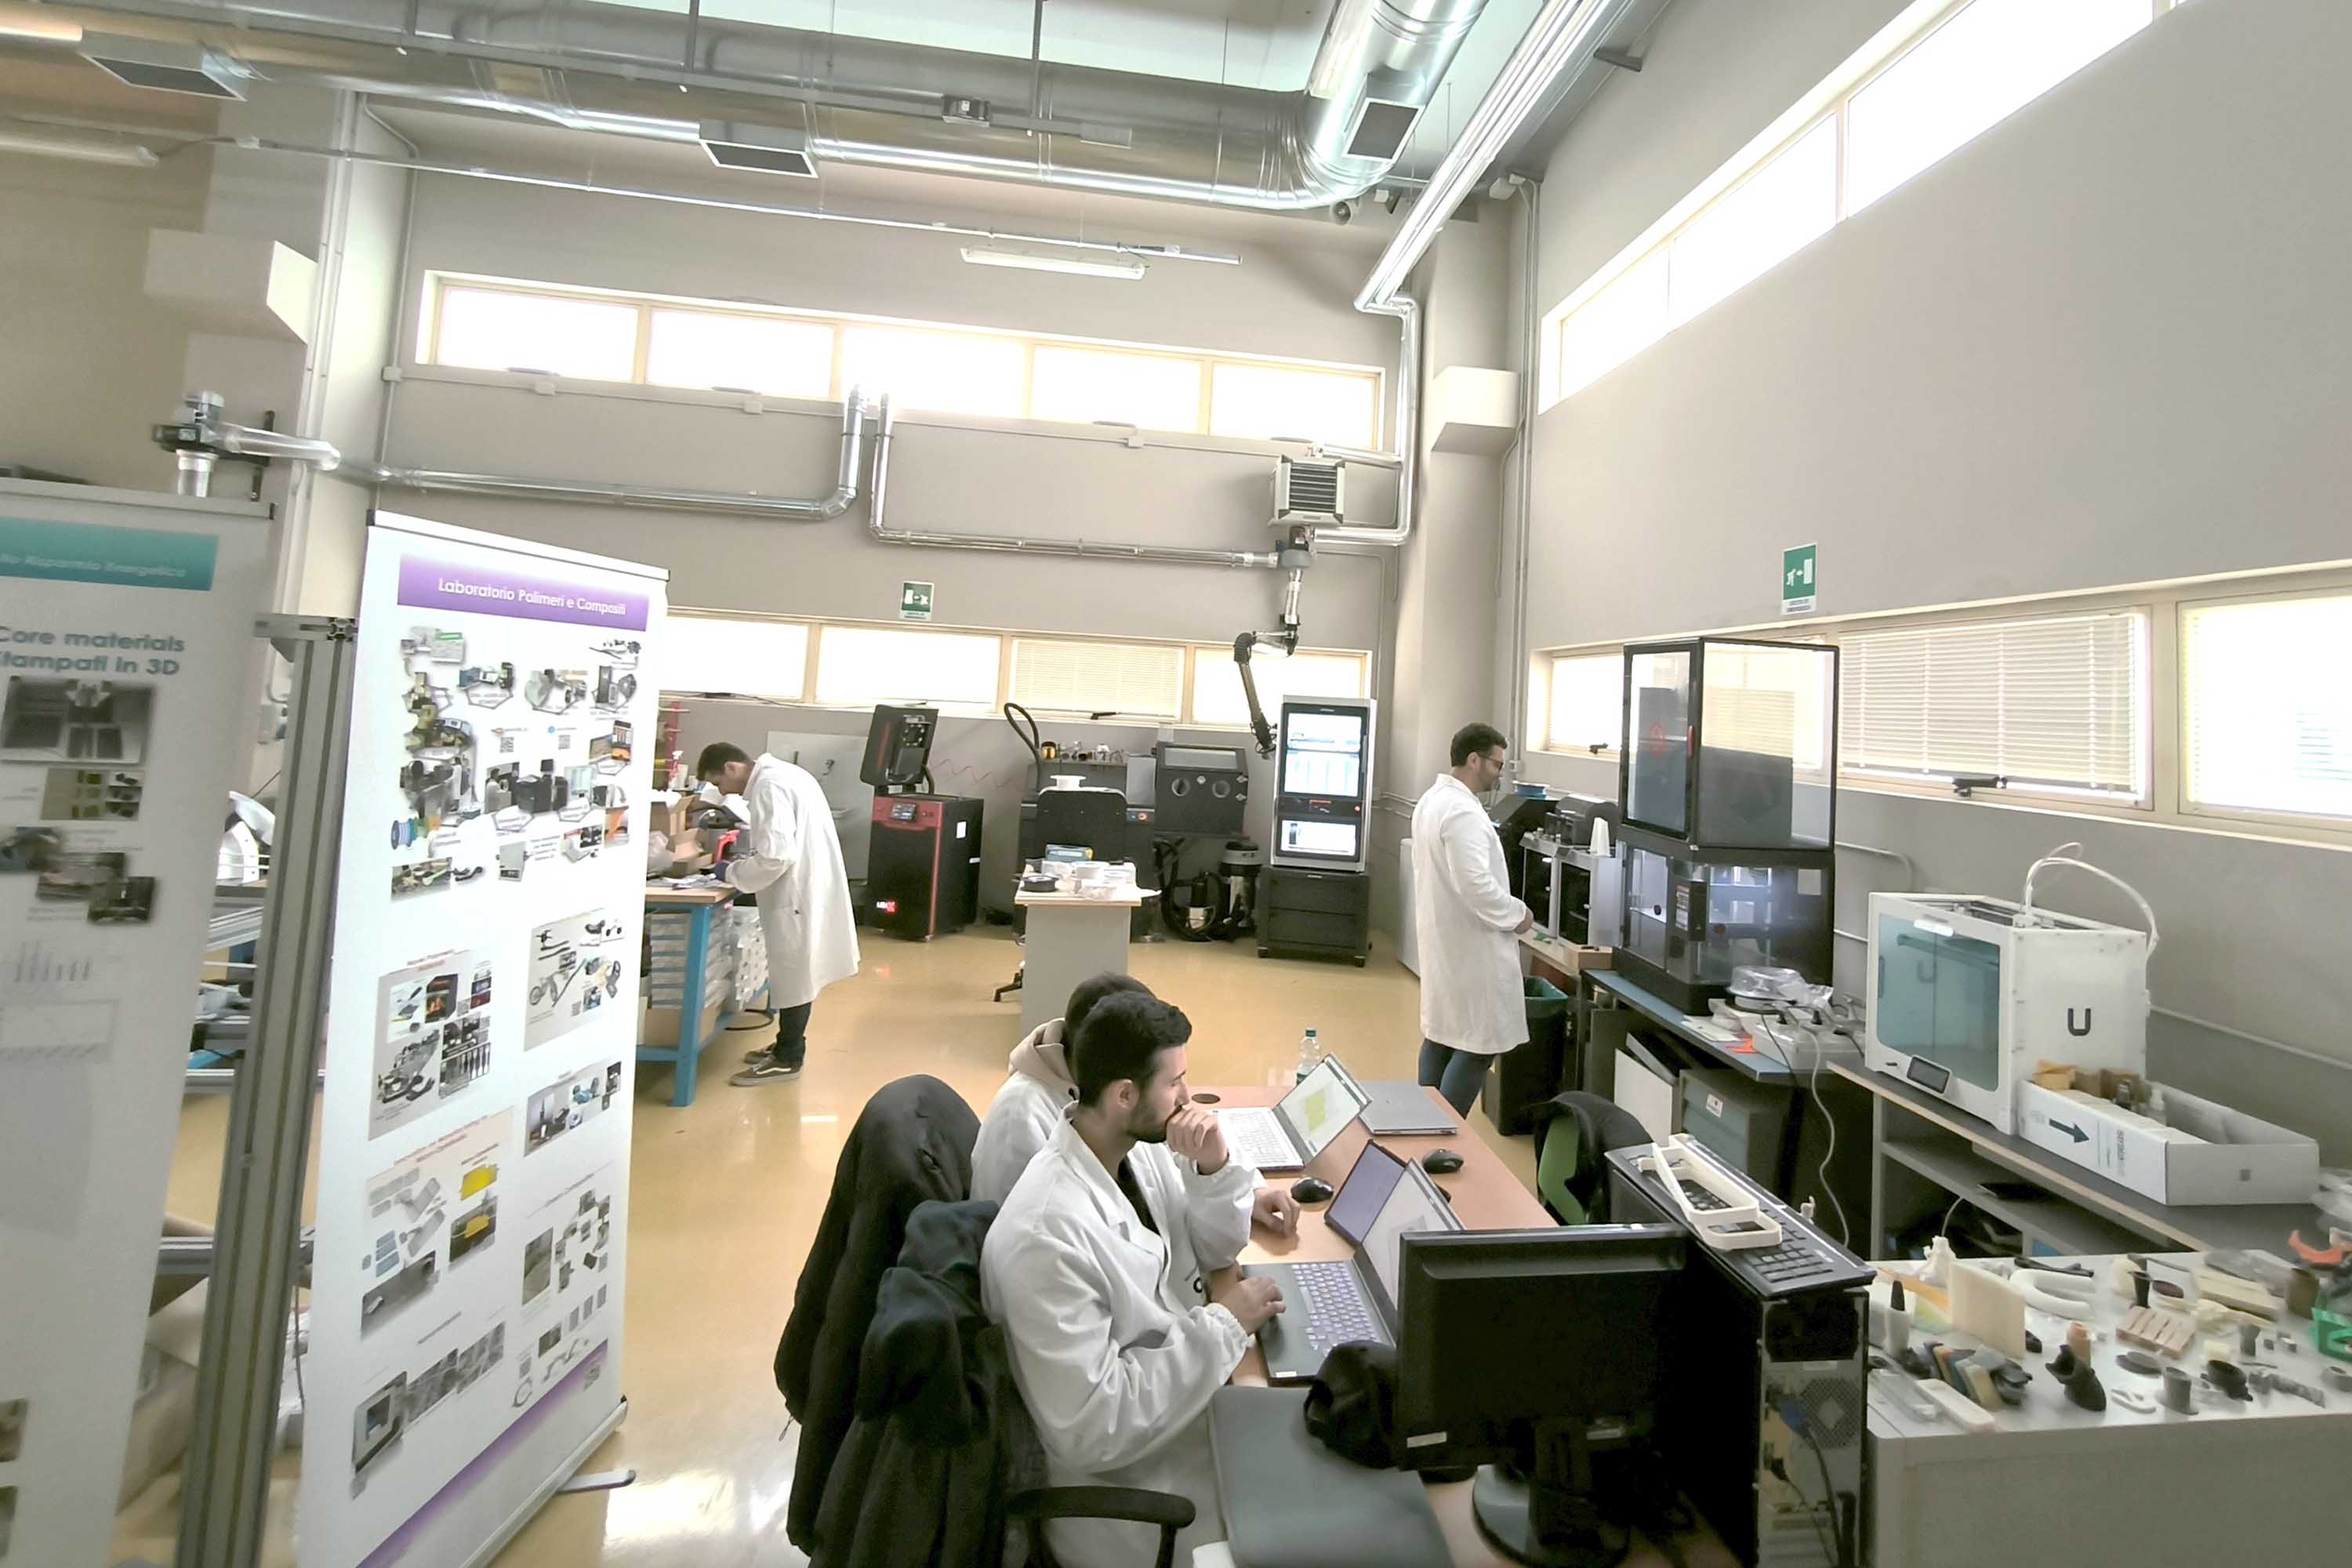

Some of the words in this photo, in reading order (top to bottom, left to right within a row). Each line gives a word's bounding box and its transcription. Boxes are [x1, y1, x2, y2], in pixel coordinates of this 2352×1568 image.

[438, 578, 515, 601] Laboratorio
[518, 589, 564, 608] Polimeri
[566, 599, 575, 608] e
[577, 597, 627, 615] Compositi
[64, 632, 185, 652] materials
[145, 659, 180, 675] 3D
[2067, 1008, 2091, 1036] U
